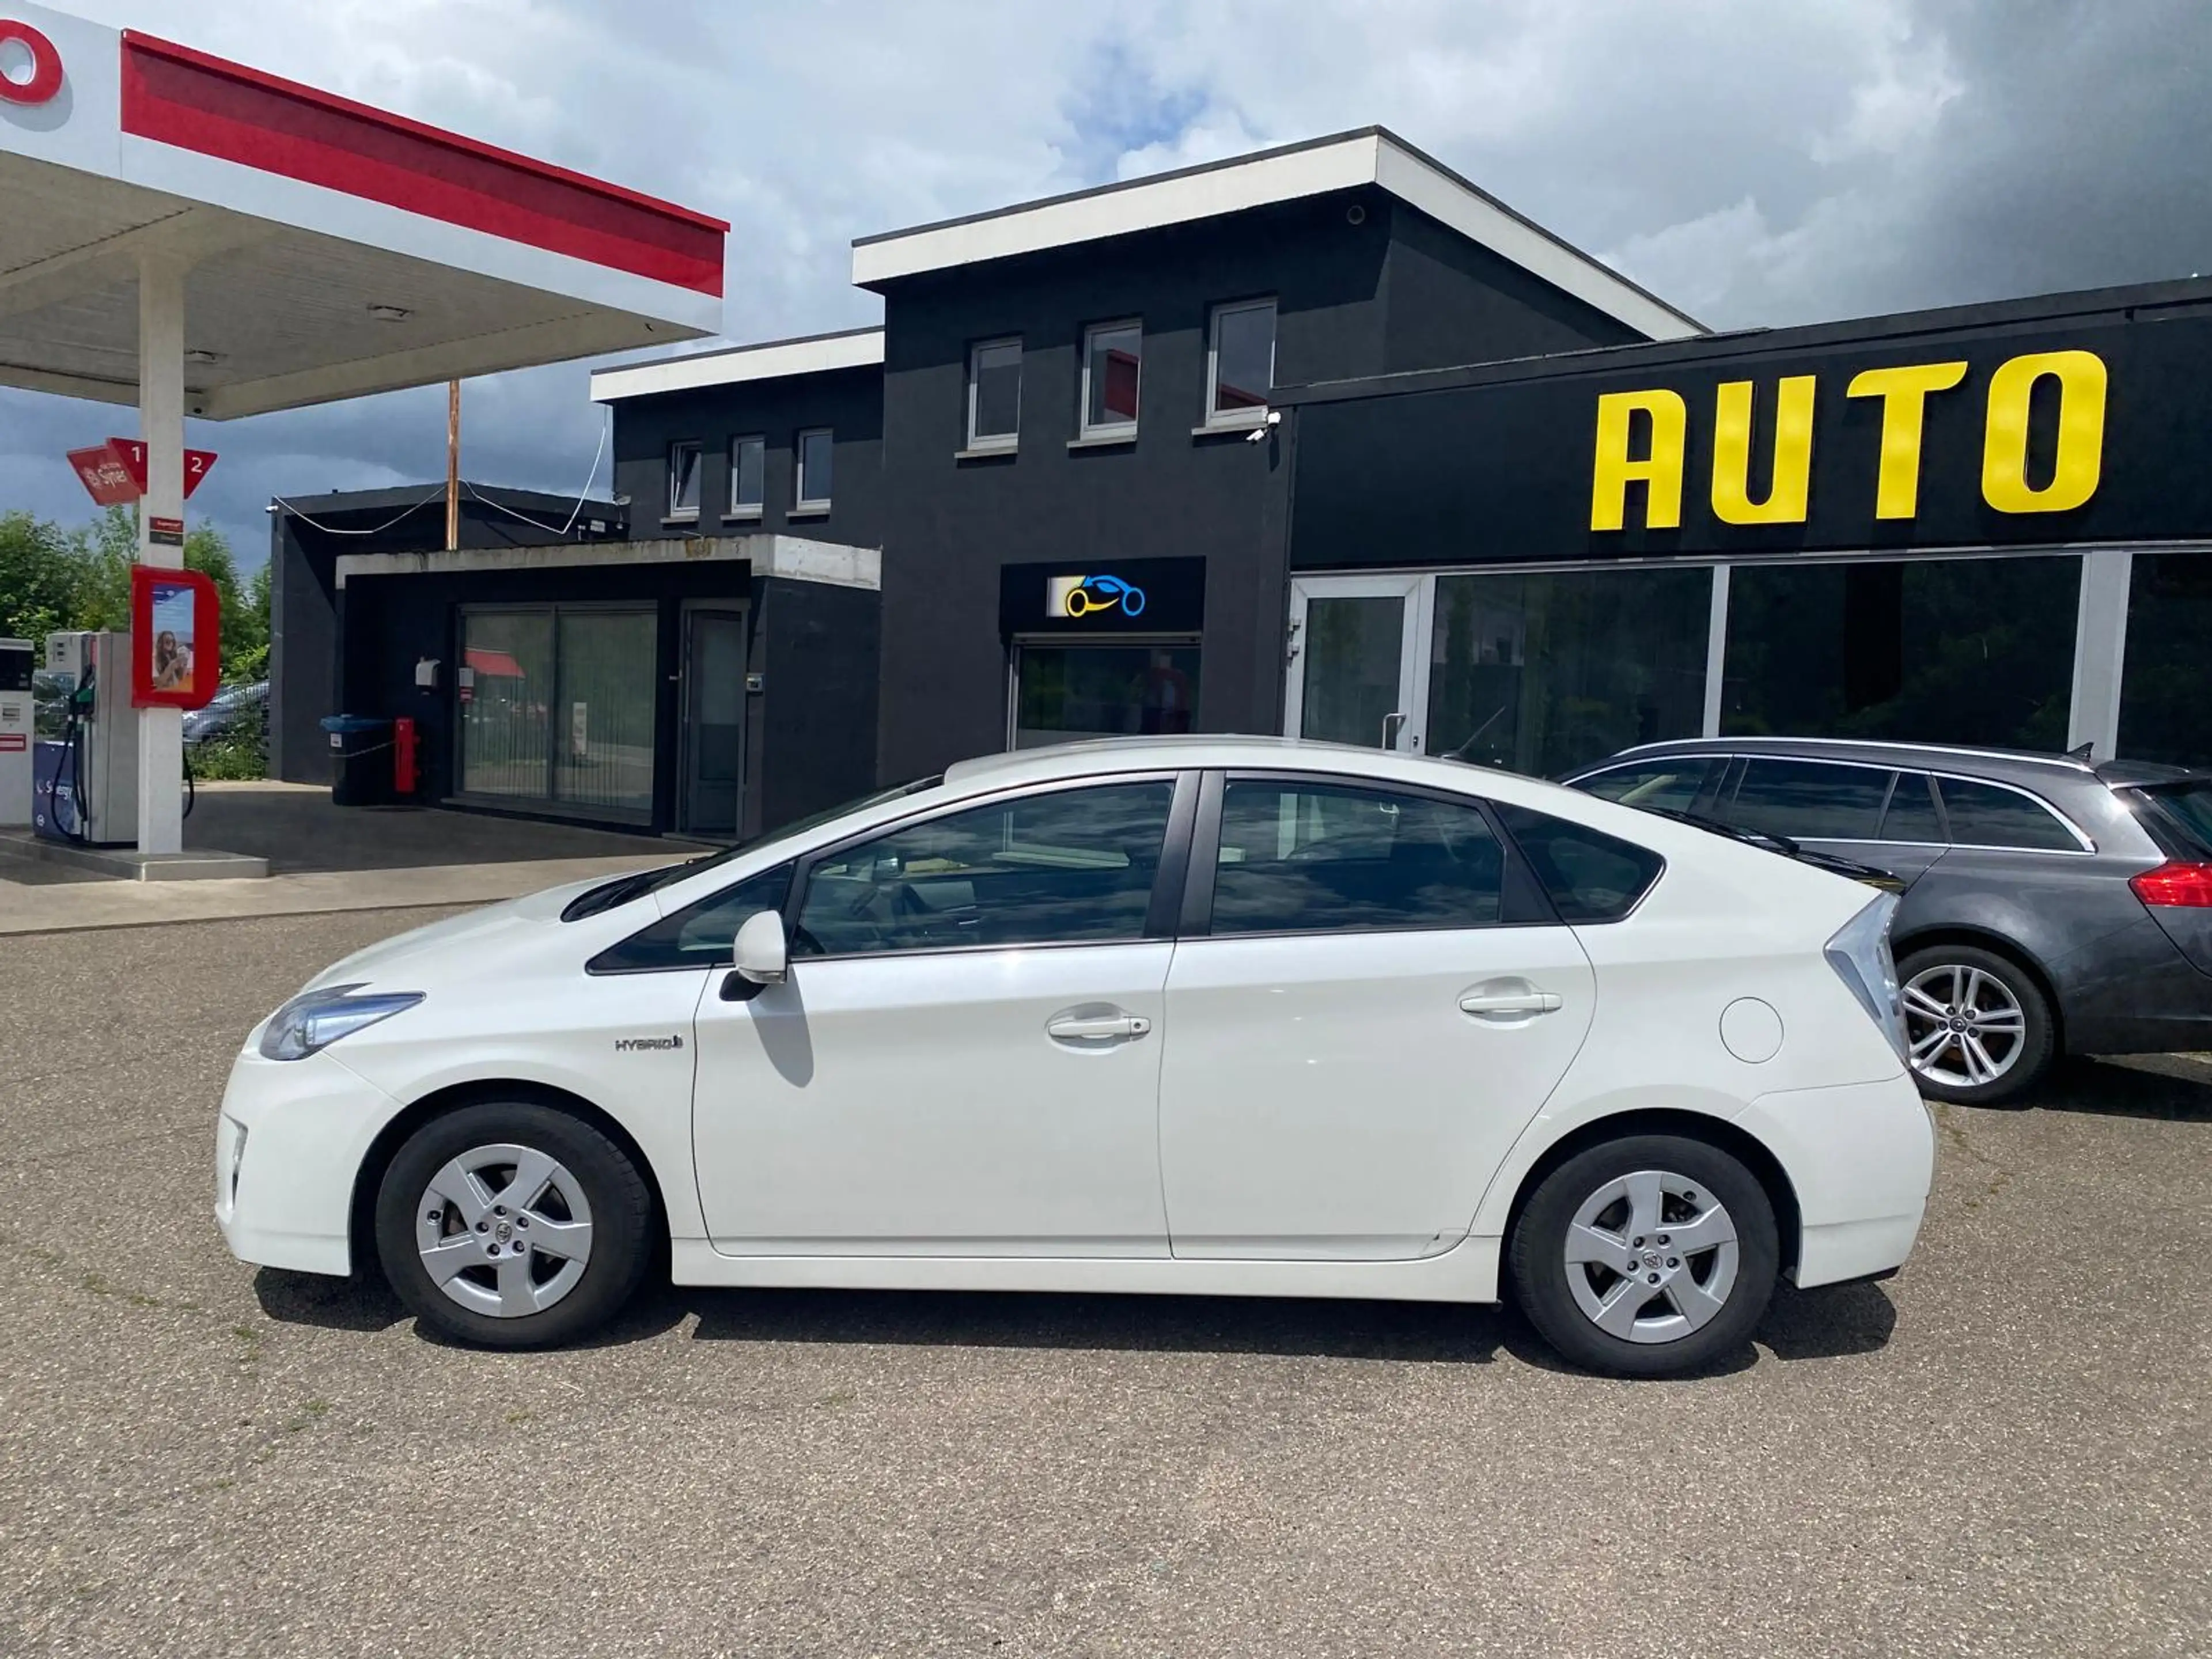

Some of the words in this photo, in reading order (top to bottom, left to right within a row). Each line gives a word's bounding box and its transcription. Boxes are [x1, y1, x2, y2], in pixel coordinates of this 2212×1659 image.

[1590, 350, 2108, 532] AUTO
[131, 446, 141, 463] 1
[191, 456, 203, 473] 2
[615, 1039, 672, 1051] HYBRID
